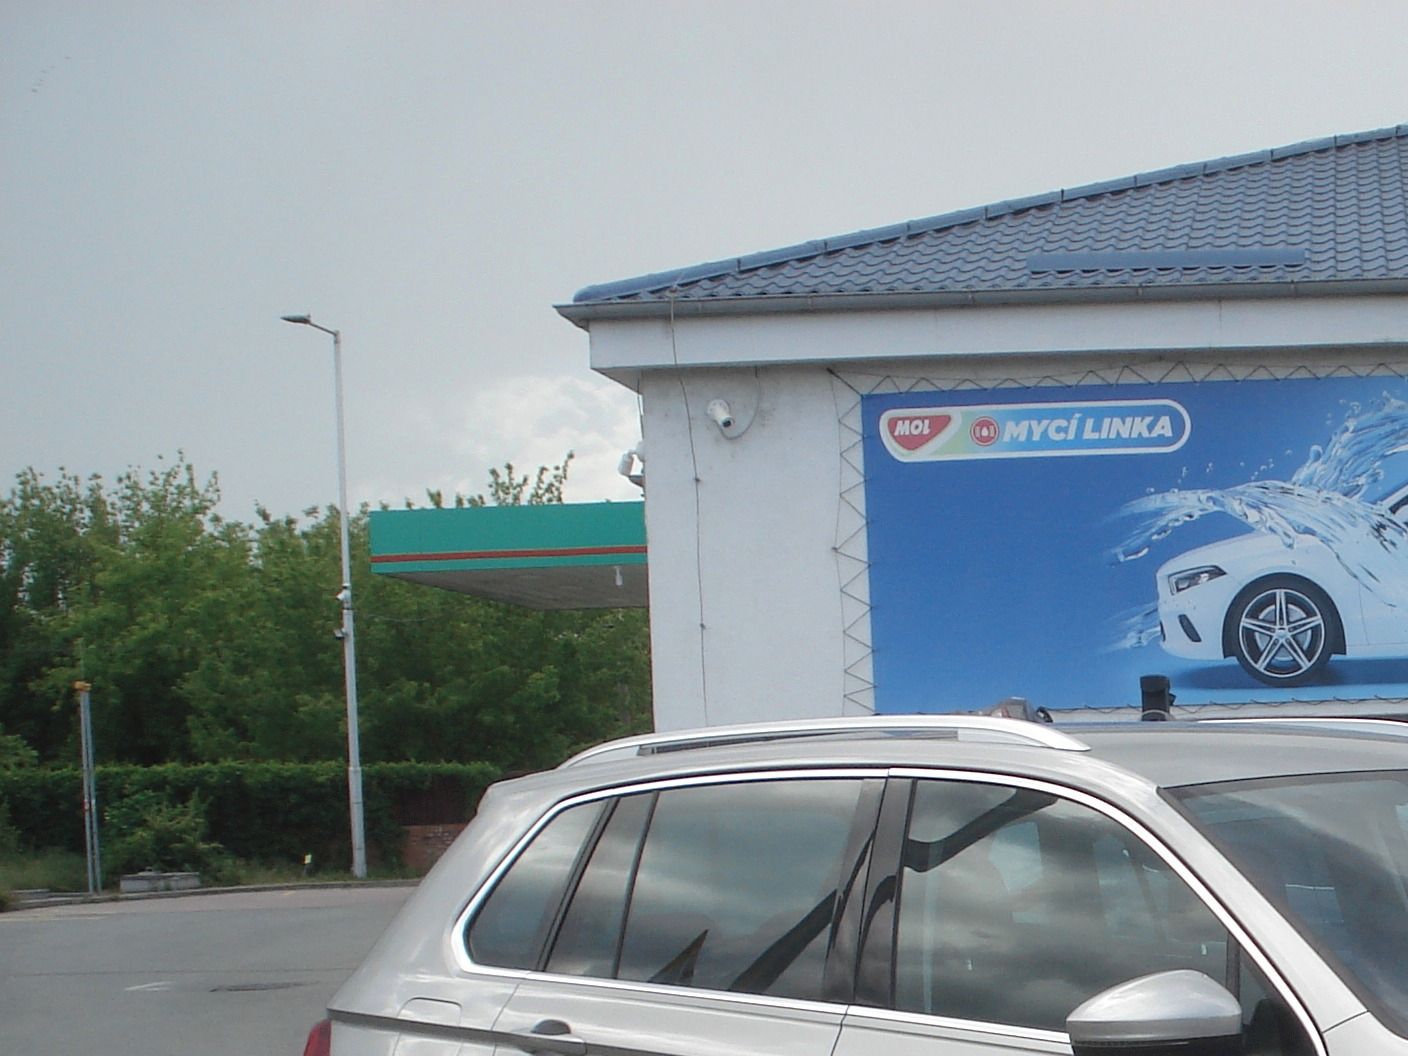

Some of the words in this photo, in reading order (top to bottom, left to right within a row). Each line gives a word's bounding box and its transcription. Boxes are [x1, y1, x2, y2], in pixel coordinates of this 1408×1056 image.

[894, 419, 931, 436] MOL
[1002, 413, 1081, 443] MYCÍ
[1083, 416, 1173, 440] LINKA
